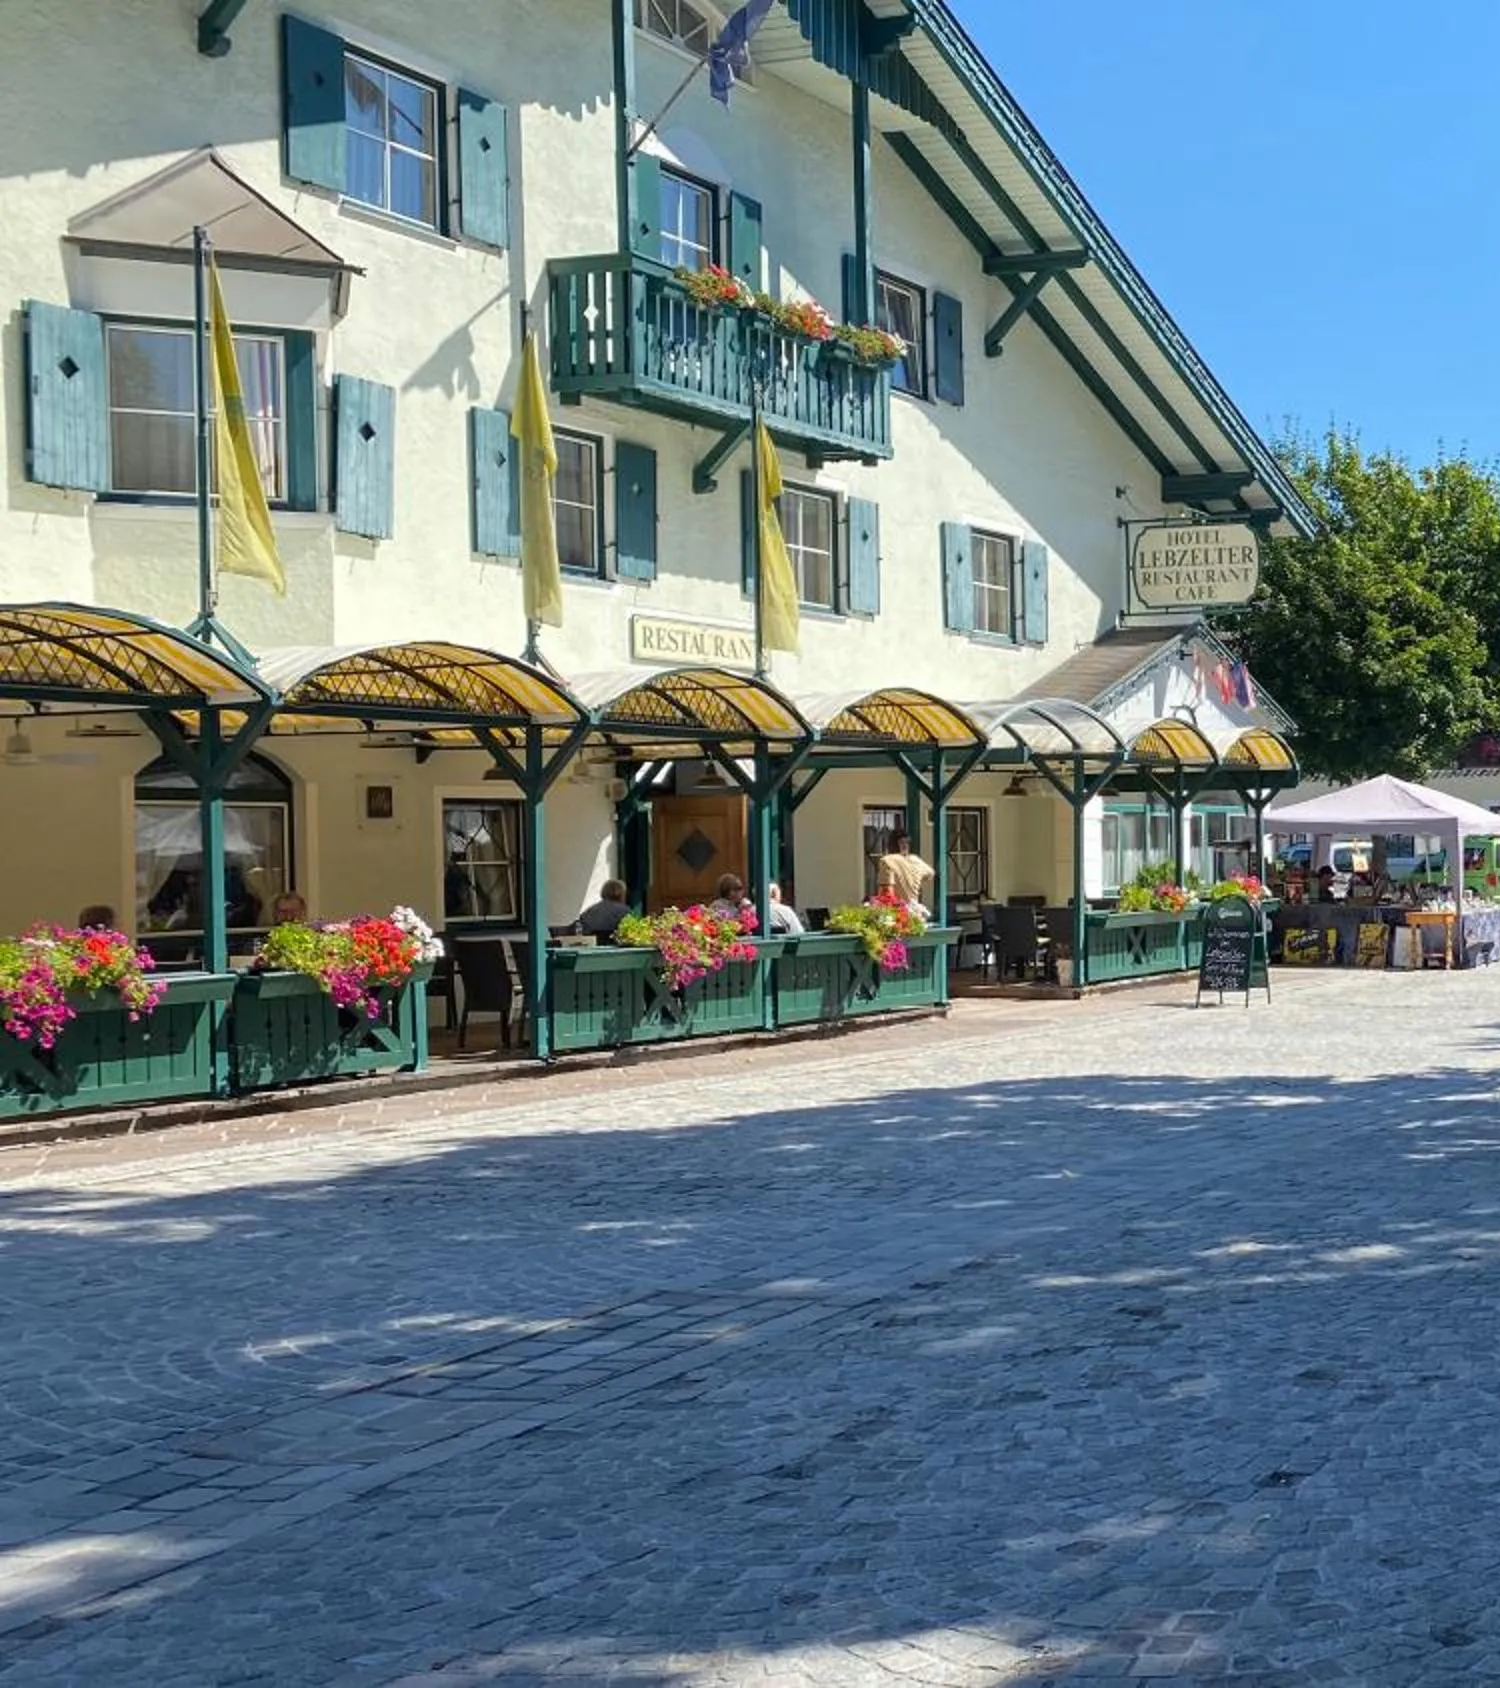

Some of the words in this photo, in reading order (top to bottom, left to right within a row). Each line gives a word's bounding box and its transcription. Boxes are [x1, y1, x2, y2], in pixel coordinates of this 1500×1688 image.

[1167, 530, 1225, 546] HOTEL
[1139, 546, 1254, 569] LEBZELTER
[1142, 567, 1253, 587] RESTAURANT
[642, 625, 757, 660] RESTAURAN
